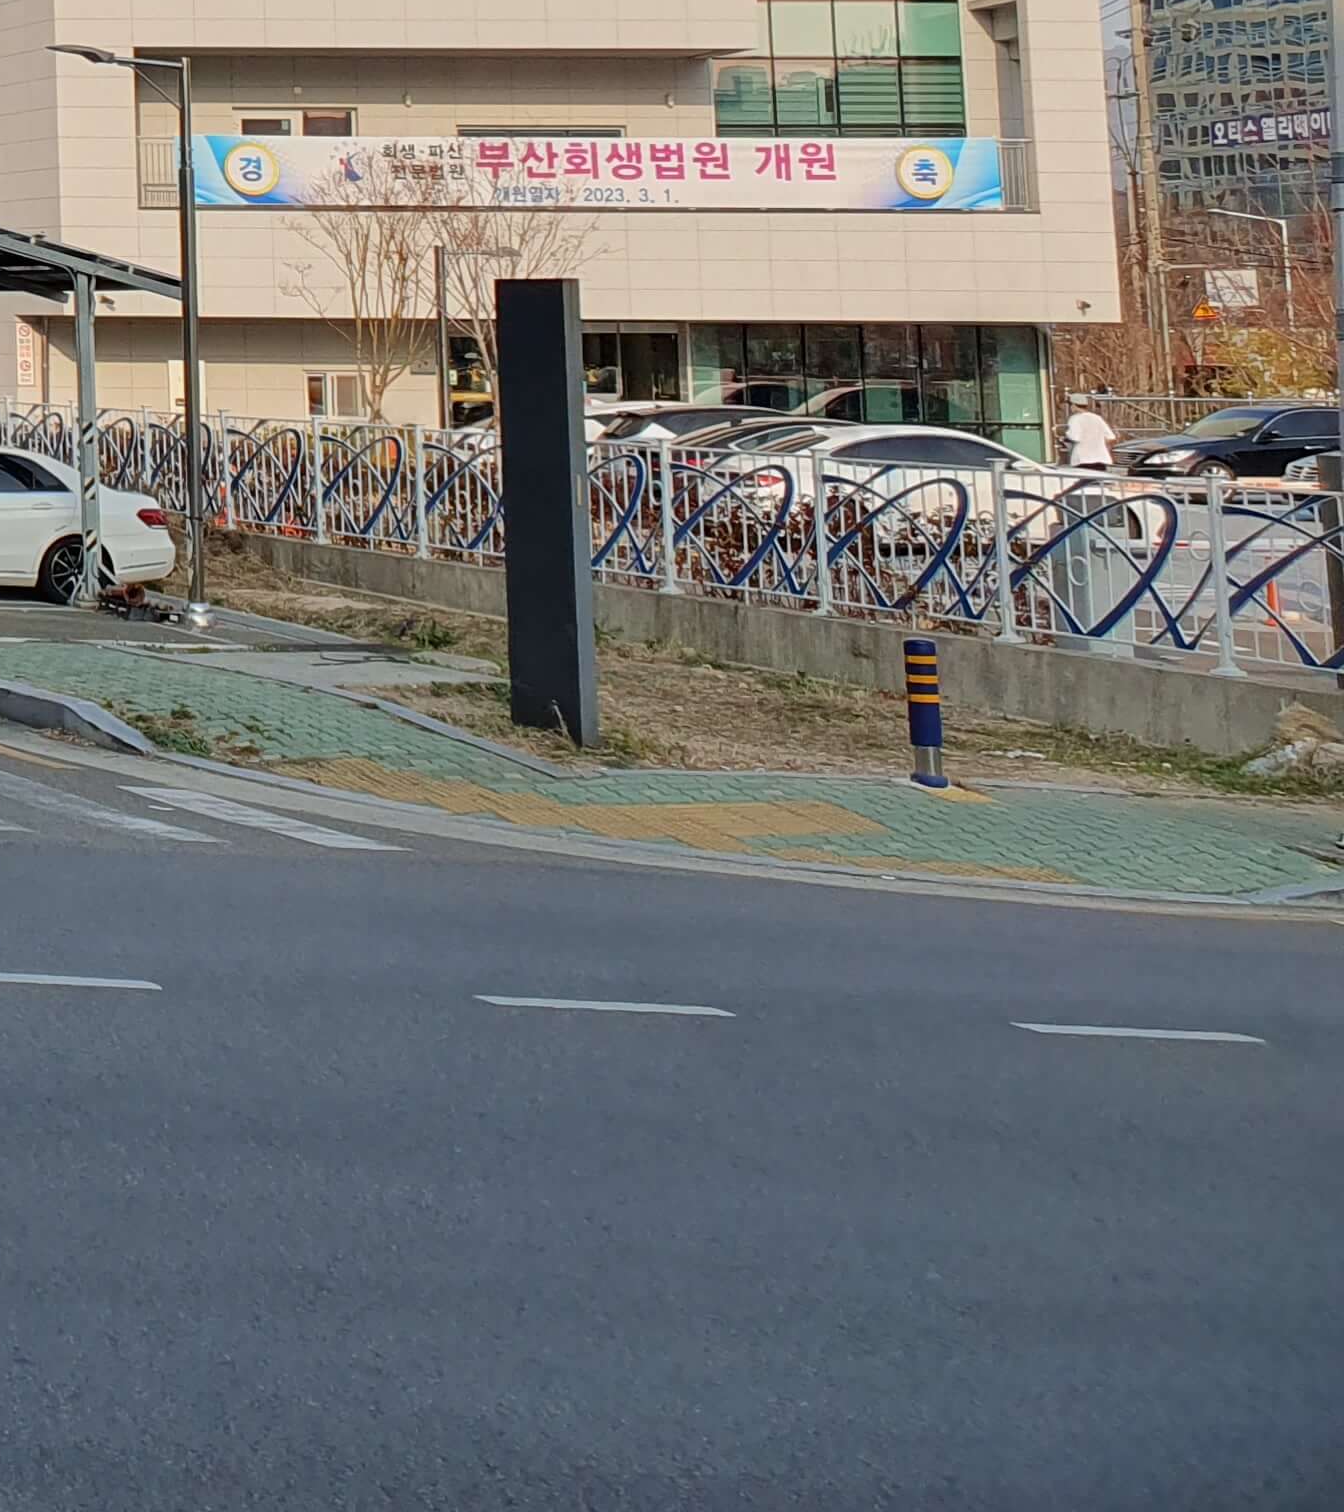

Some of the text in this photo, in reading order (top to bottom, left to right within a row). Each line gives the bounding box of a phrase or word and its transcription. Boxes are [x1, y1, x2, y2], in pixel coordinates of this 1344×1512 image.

[238, 156, 263, 182] 경
[476, 141, 838, 181] 부산회생법원 개원
[912, 159, 938, 185] 축
[584, 188, 630, 203] 2023.
[639, 188, 655, 203] 3.
[664, 188, 679, 203] 1.
